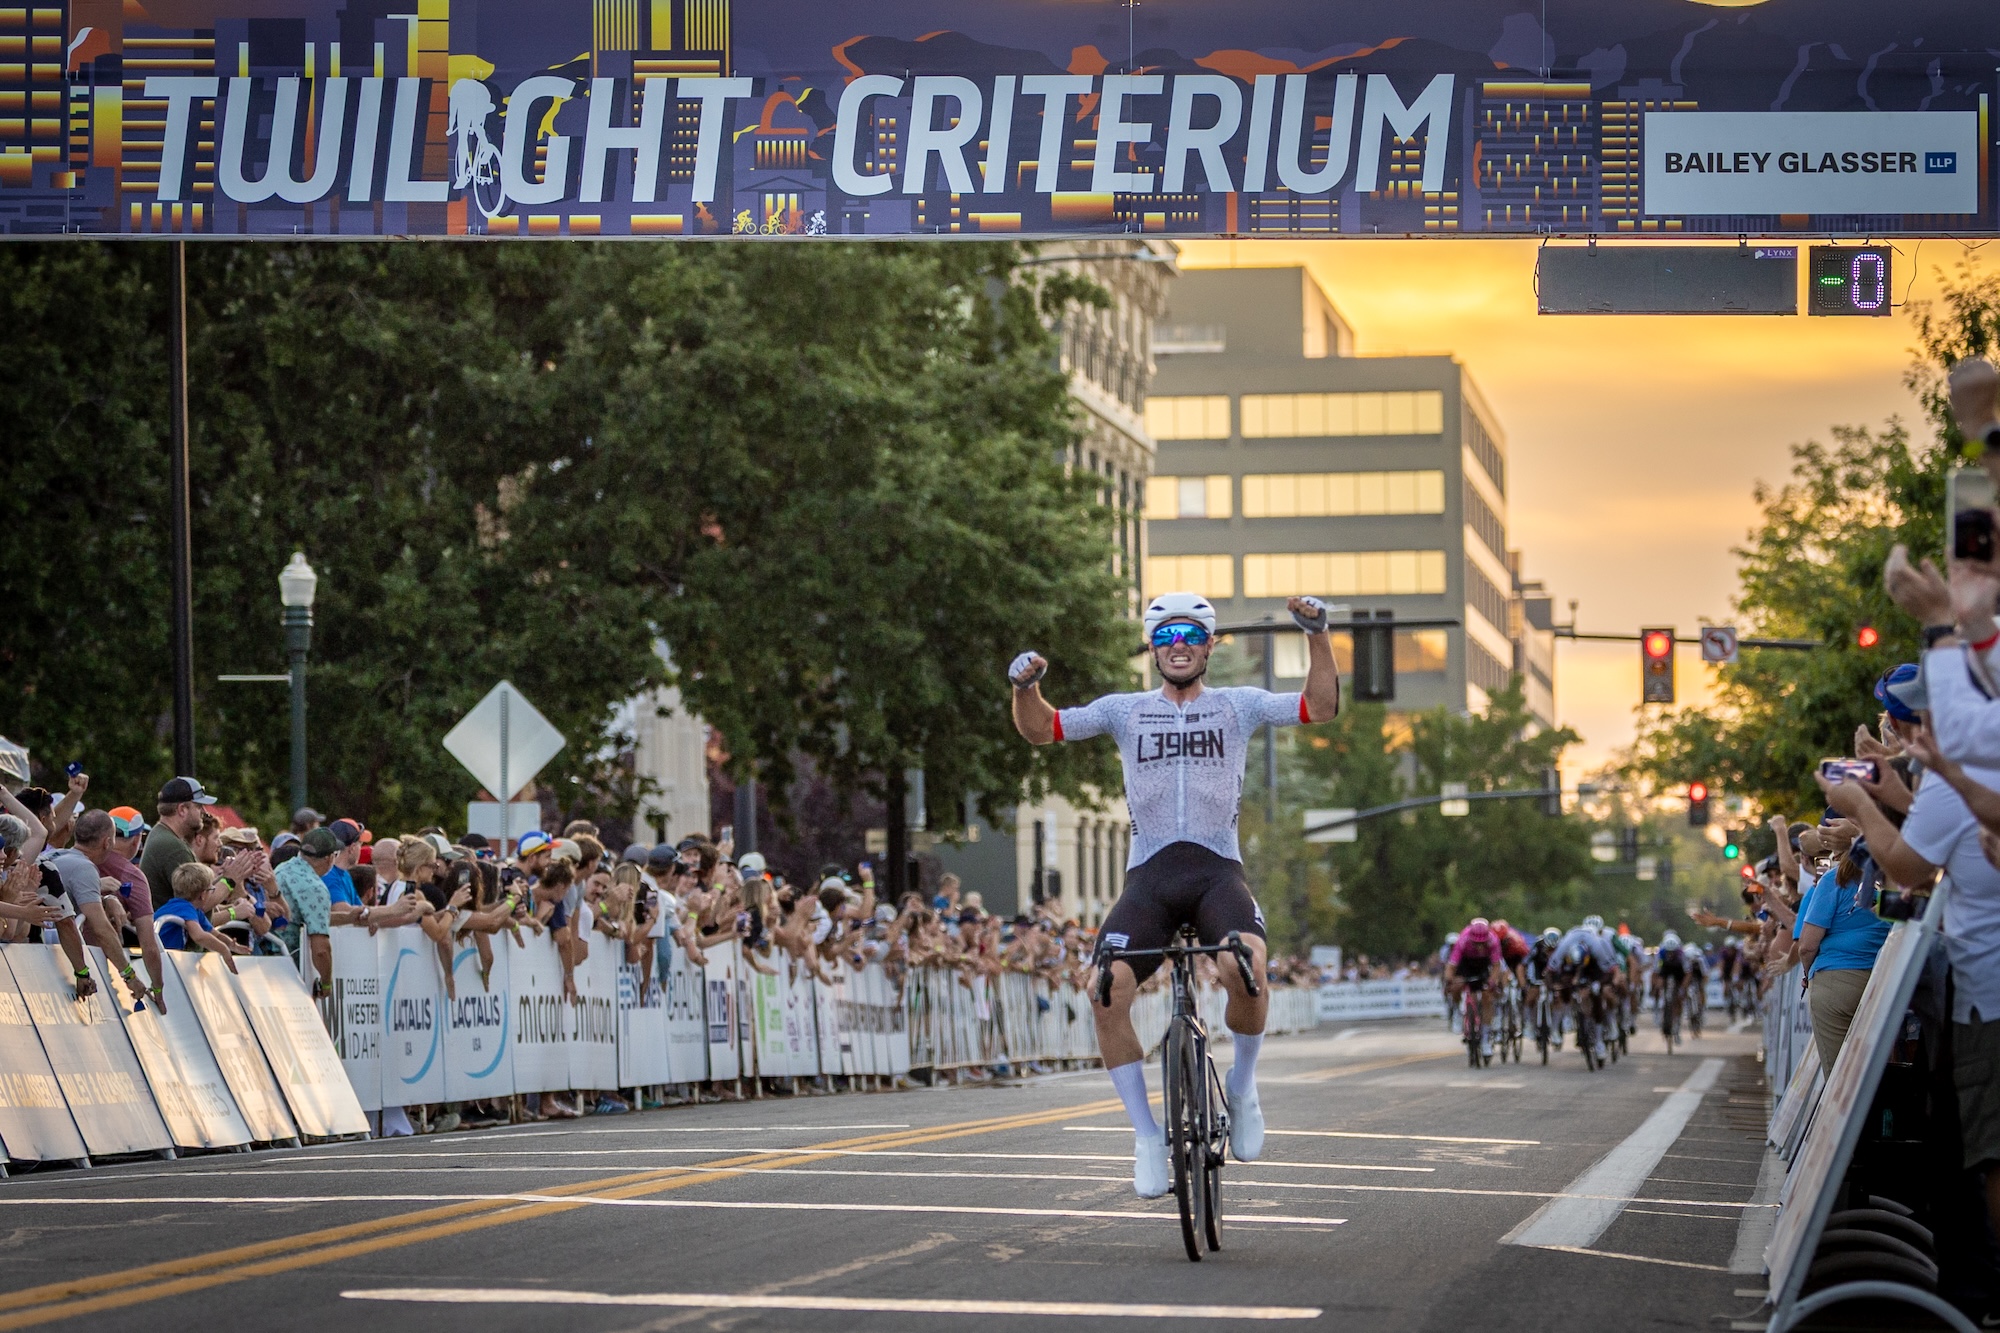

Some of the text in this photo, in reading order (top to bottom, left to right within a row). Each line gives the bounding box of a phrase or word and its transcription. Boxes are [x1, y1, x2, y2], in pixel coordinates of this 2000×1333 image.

[831, 74, 1455, 196] CRITERIUM
[1665, 151, 1953, 174] BAILEY GLASSER LLP
[1767, 249, 1793, 257] LYNX
[346, 978, 375, 996] COLLEGE
[452, 995, 500, 1029] LACTALIS
[517, 975, 566, 1045] micron
[472, 1038, 482, 1052] USA
